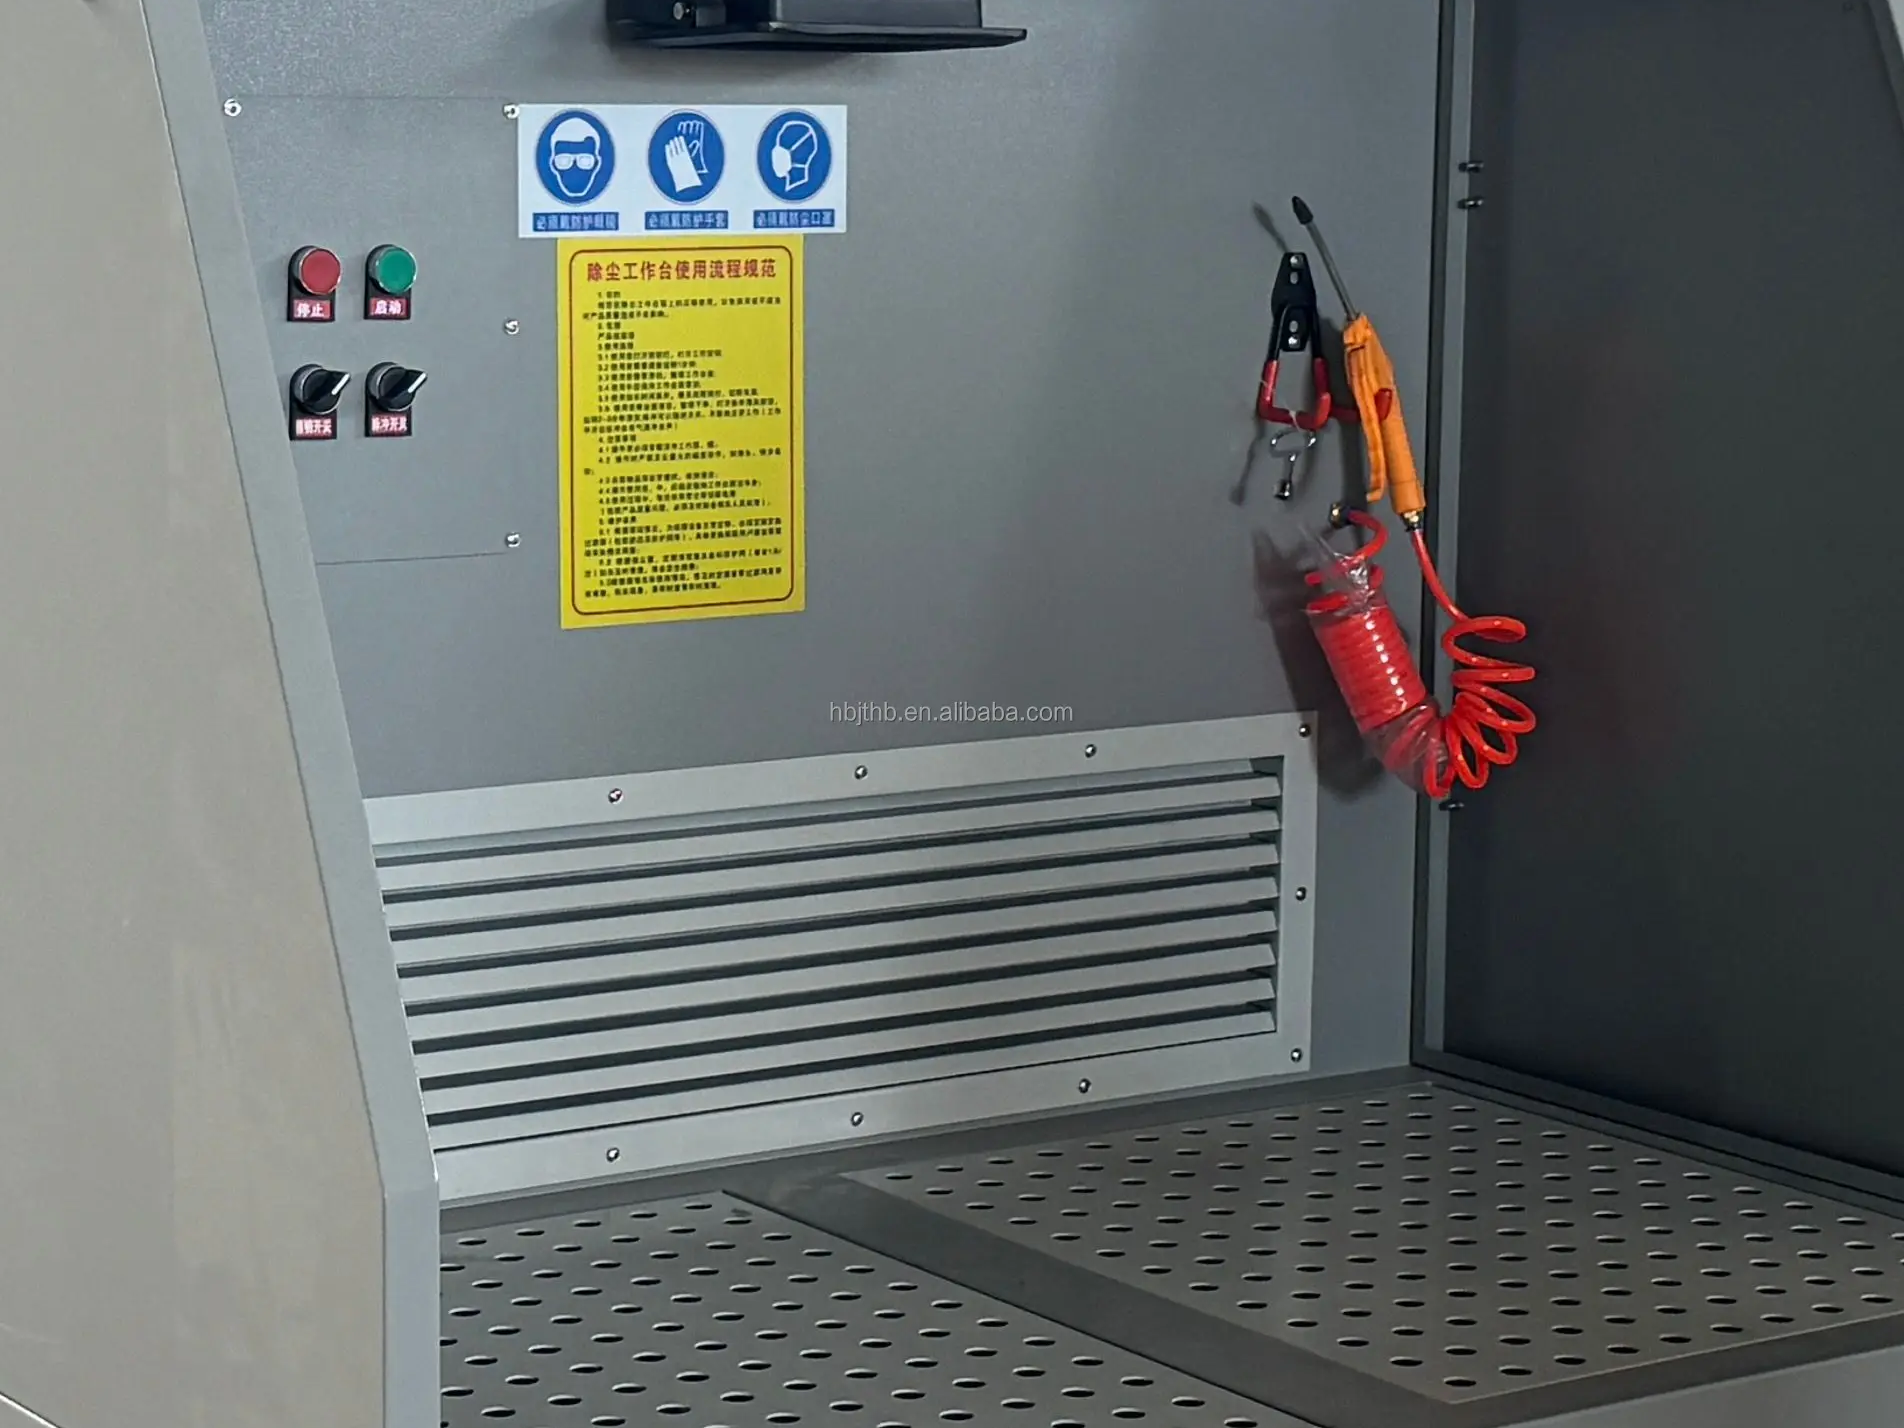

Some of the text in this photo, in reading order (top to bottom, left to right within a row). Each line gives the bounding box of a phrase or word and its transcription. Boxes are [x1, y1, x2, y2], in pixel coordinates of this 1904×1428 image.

[586, 258, 777, 282] 除尘工作台使用流程规范
[296, 303, 324, 318] 停止
[375, 300, 402, 315] 启动
